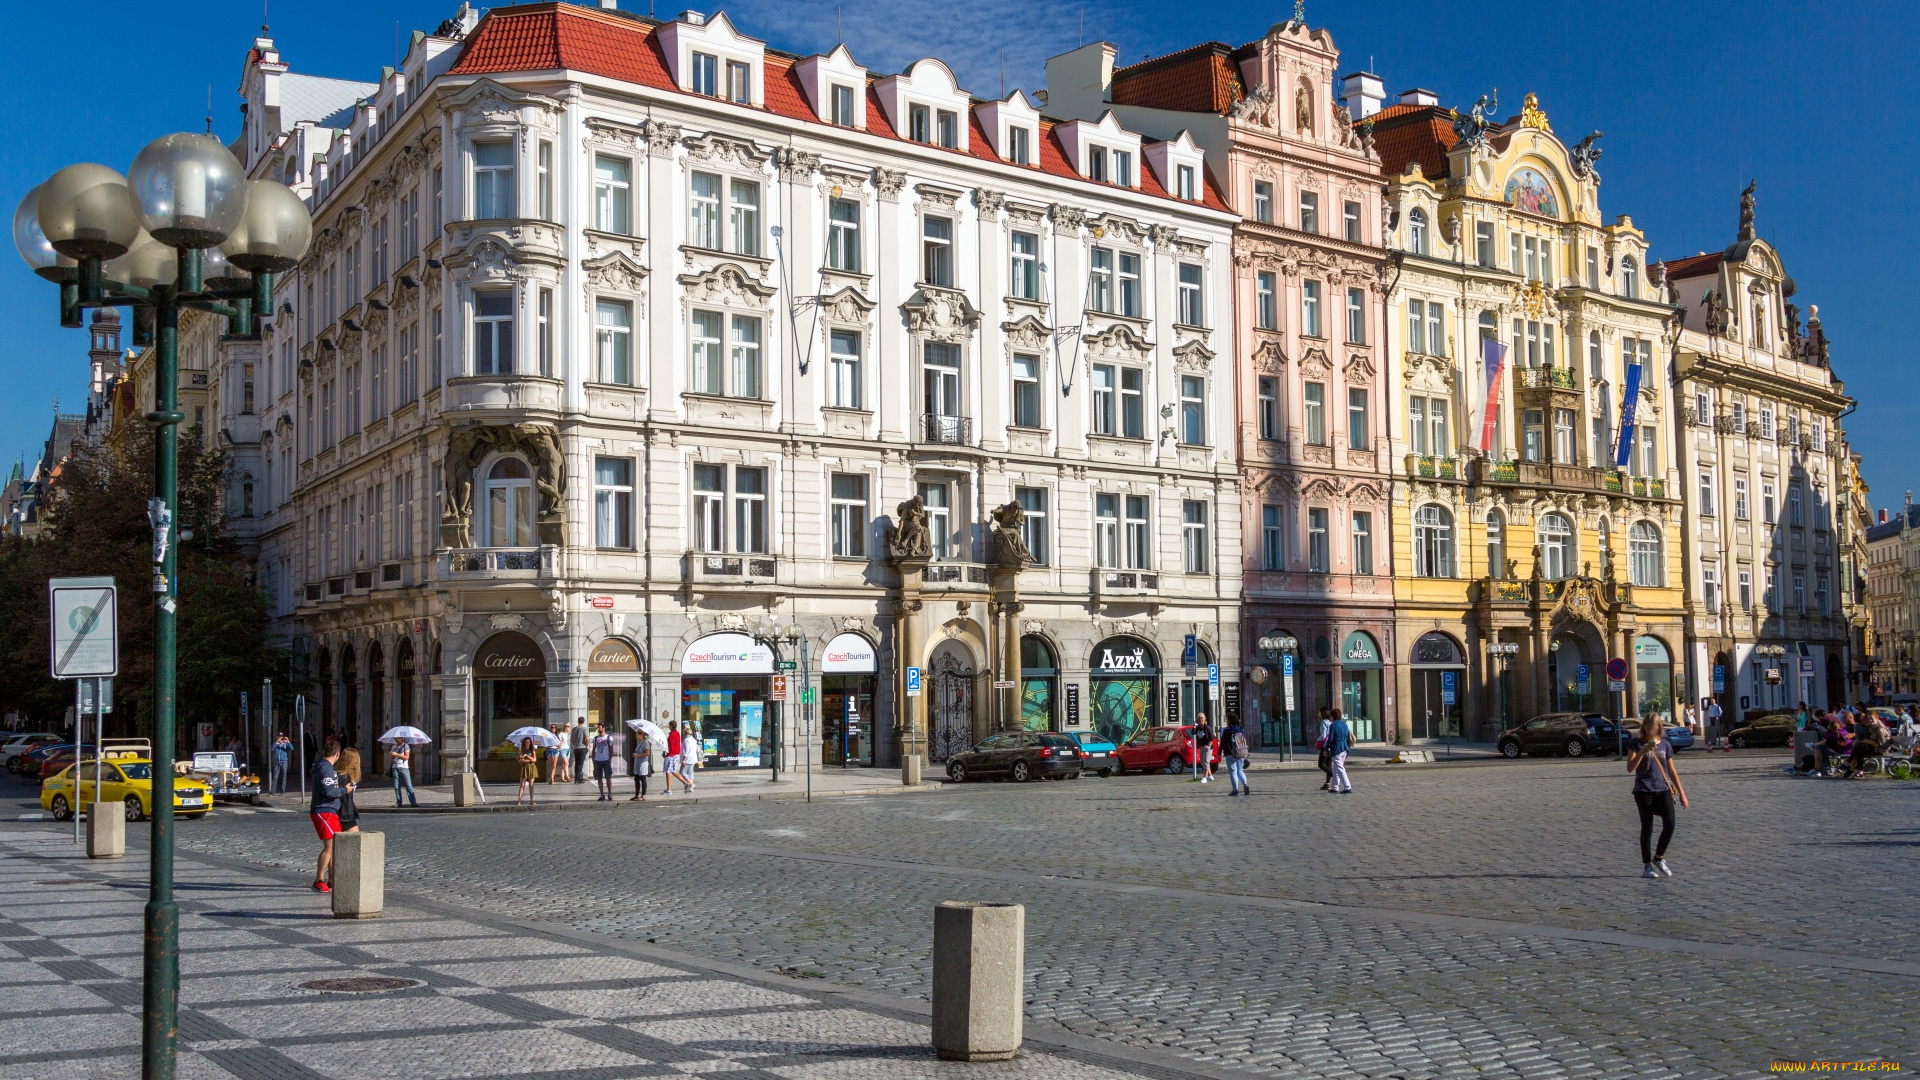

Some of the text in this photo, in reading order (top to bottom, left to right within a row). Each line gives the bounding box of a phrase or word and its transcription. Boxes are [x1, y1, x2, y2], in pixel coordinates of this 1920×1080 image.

[1187, 638, 1194, 654] P
[593, 650, 632, 663] Cartier
[690, 652, 736, 661] CzechTourism
[828, 652, 870, 660] CzechTourism
[1348, 650, 1372, 658] OMEGA
[484, 652, 536, 668] Cartier
[1285, 658, 1291, 670] P
[910, 670, 918, 683] P
[1210, 666, 1216, 678] P
[1580, 667, 1586, 677] P
[1716, 668, 1722, 677] P
[1445, 674, 1452, 685] P
